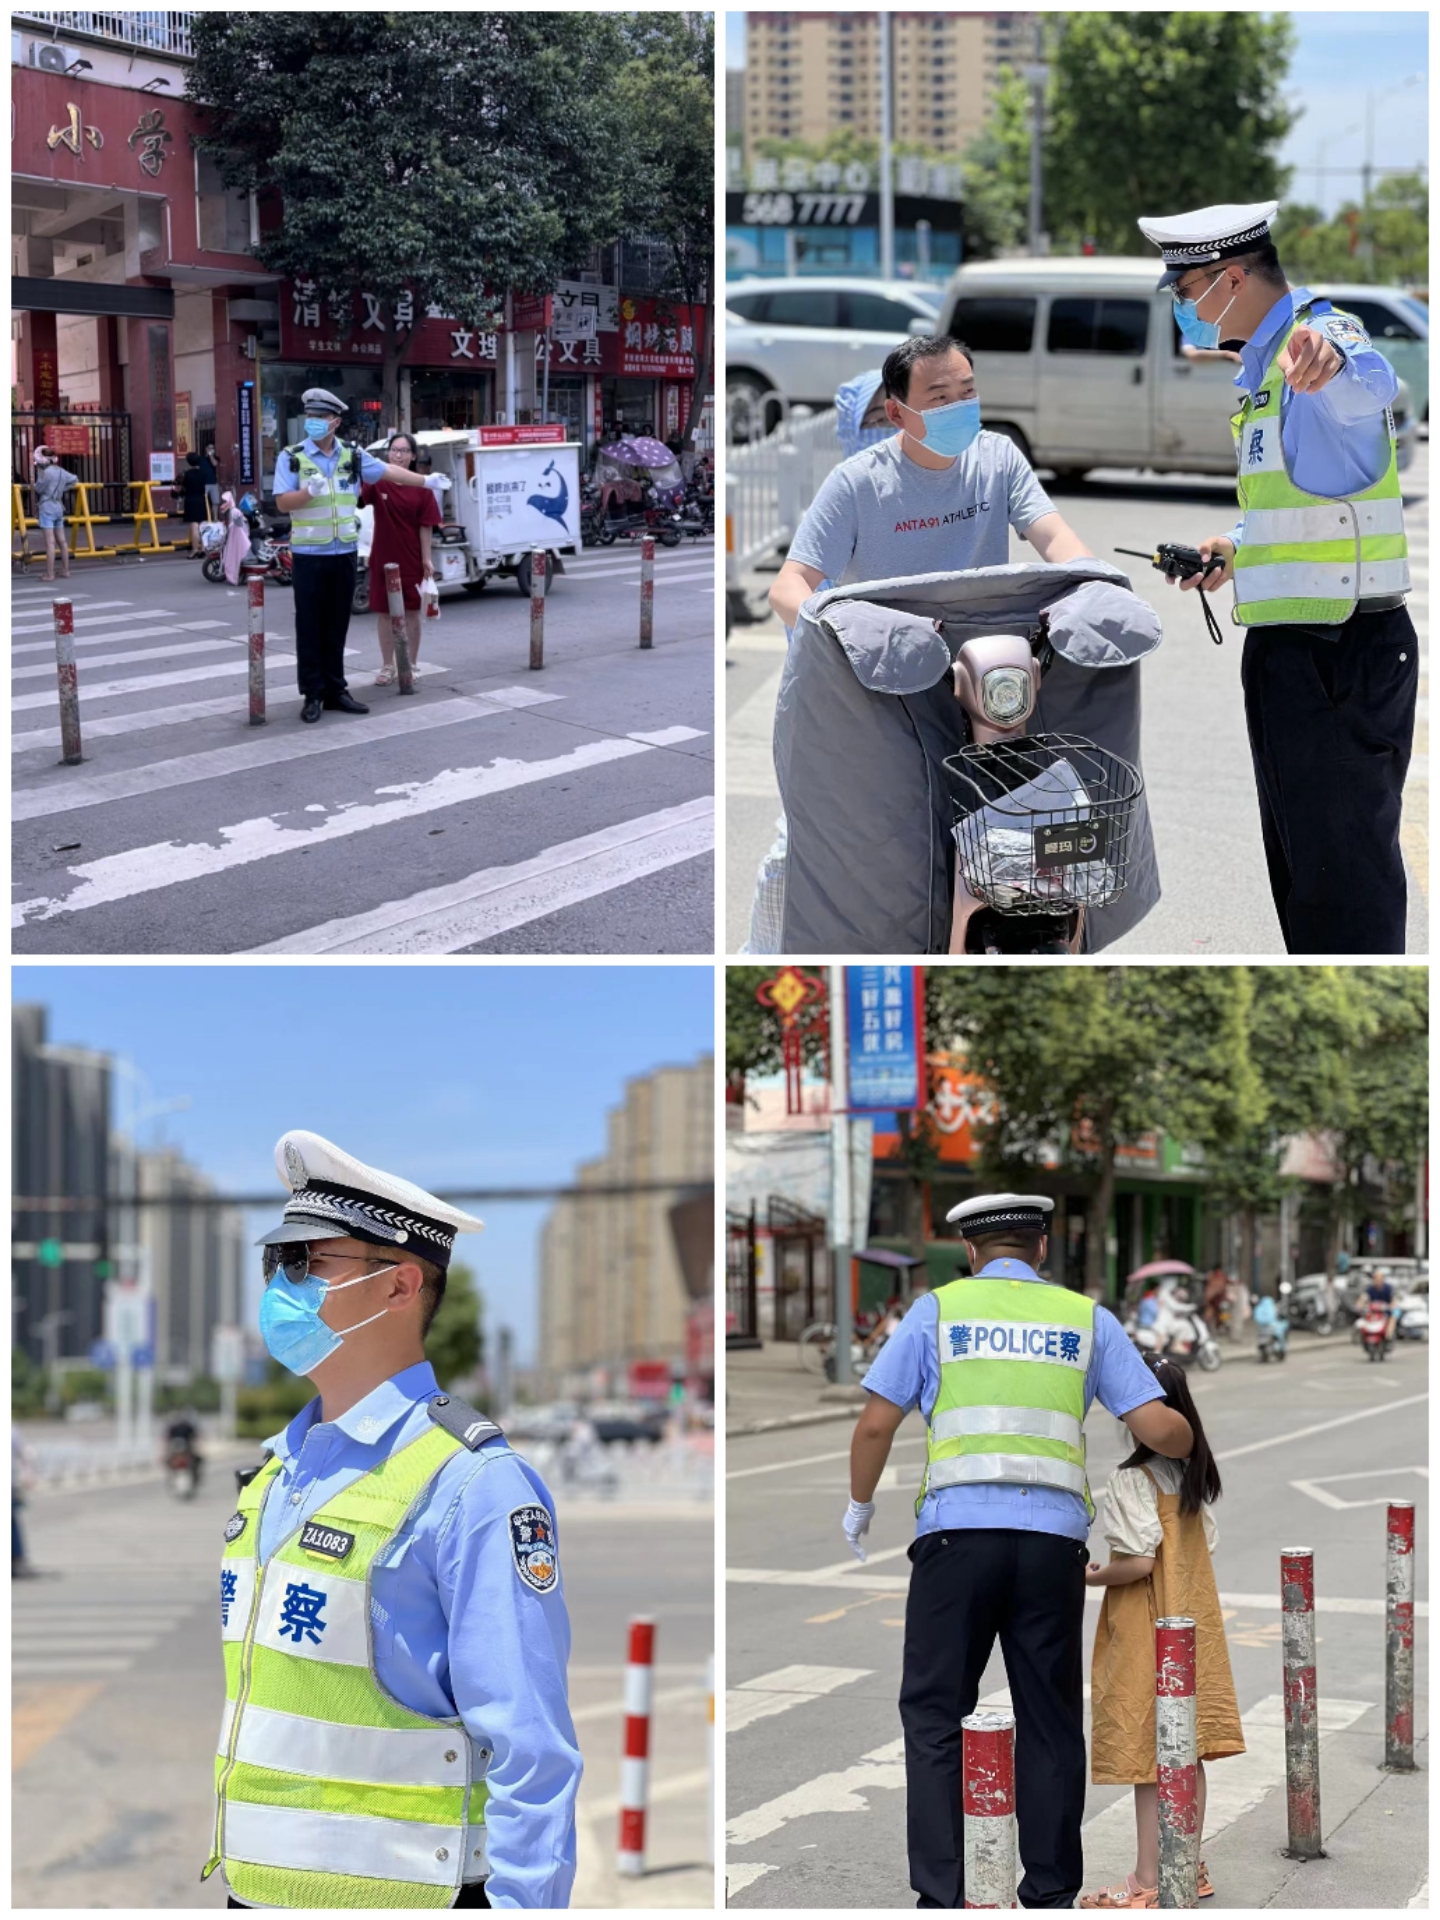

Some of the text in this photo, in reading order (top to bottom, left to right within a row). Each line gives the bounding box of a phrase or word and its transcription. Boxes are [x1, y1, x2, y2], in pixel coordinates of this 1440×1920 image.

[11, 101, 173, 177] 小学
[742, 193, 867, 224] 568 7777
[1248, 428, 1264, 465] 察
[893, 516, 941, 533] ANTA91
[302, 1526, 349, 1554] ZA1083
[278, 1582, 328, 1645] 察
